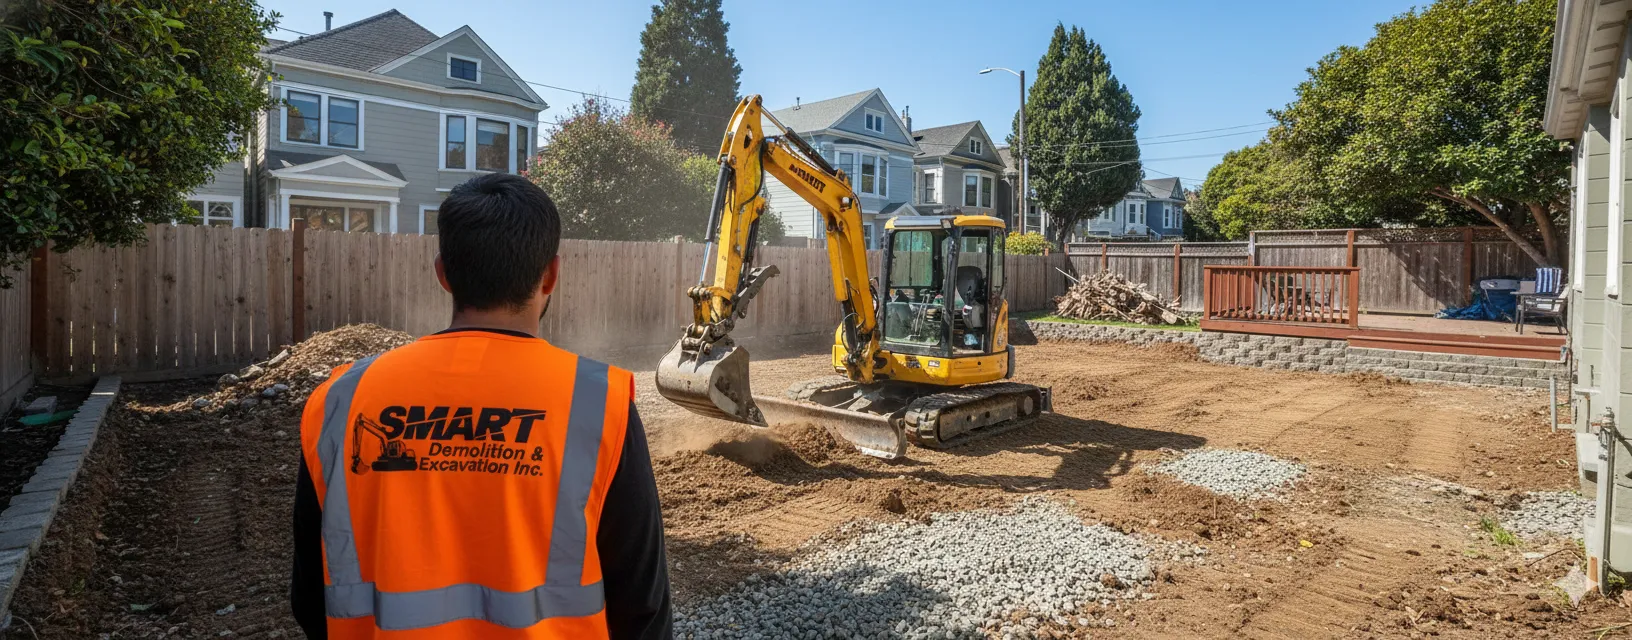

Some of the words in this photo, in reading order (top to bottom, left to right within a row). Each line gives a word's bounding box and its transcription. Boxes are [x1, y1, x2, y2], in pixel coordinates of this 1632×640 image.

[380, 406, 546, 443] SMART
[531, 446, 544, 461] &
[419, 457, 509, 474] Excavation
[513, 461, 544, 476] Inc.
